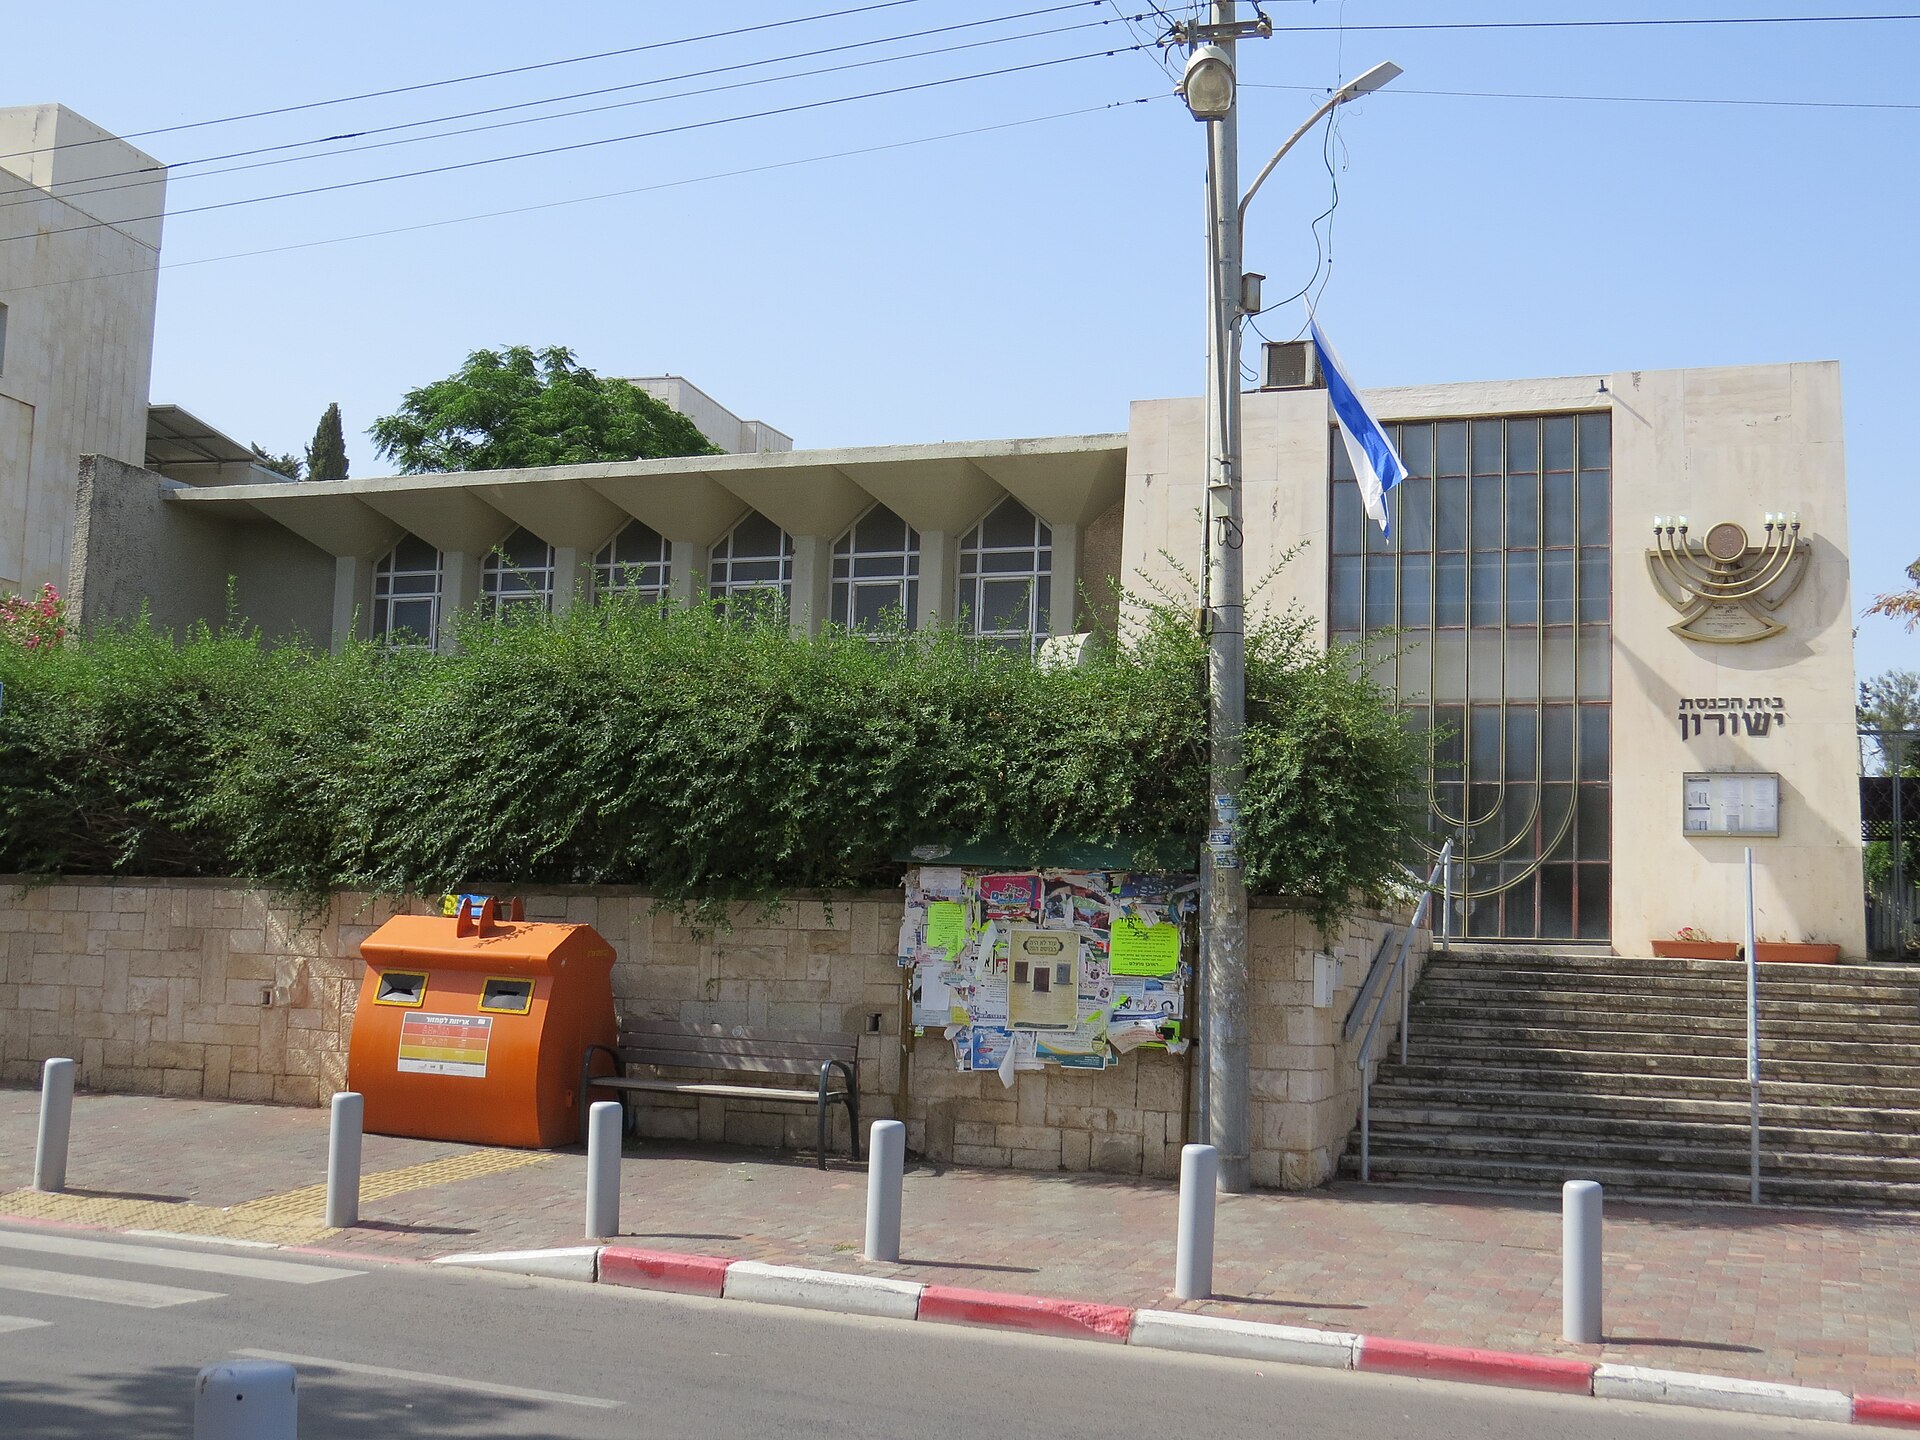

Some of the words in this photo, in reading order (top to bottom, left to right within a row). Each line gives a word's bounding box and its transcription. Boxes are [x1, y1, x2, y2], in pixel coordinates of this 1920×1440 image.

[1679, 697, 1743, 710] הכנסת
[1747, 697, 1784, 709] בית
[1678, 712, 1785, 742] ישורון
[426, 1016, 448, 1025] למחזור
[448, 1018, 470, 1026] אריזות
